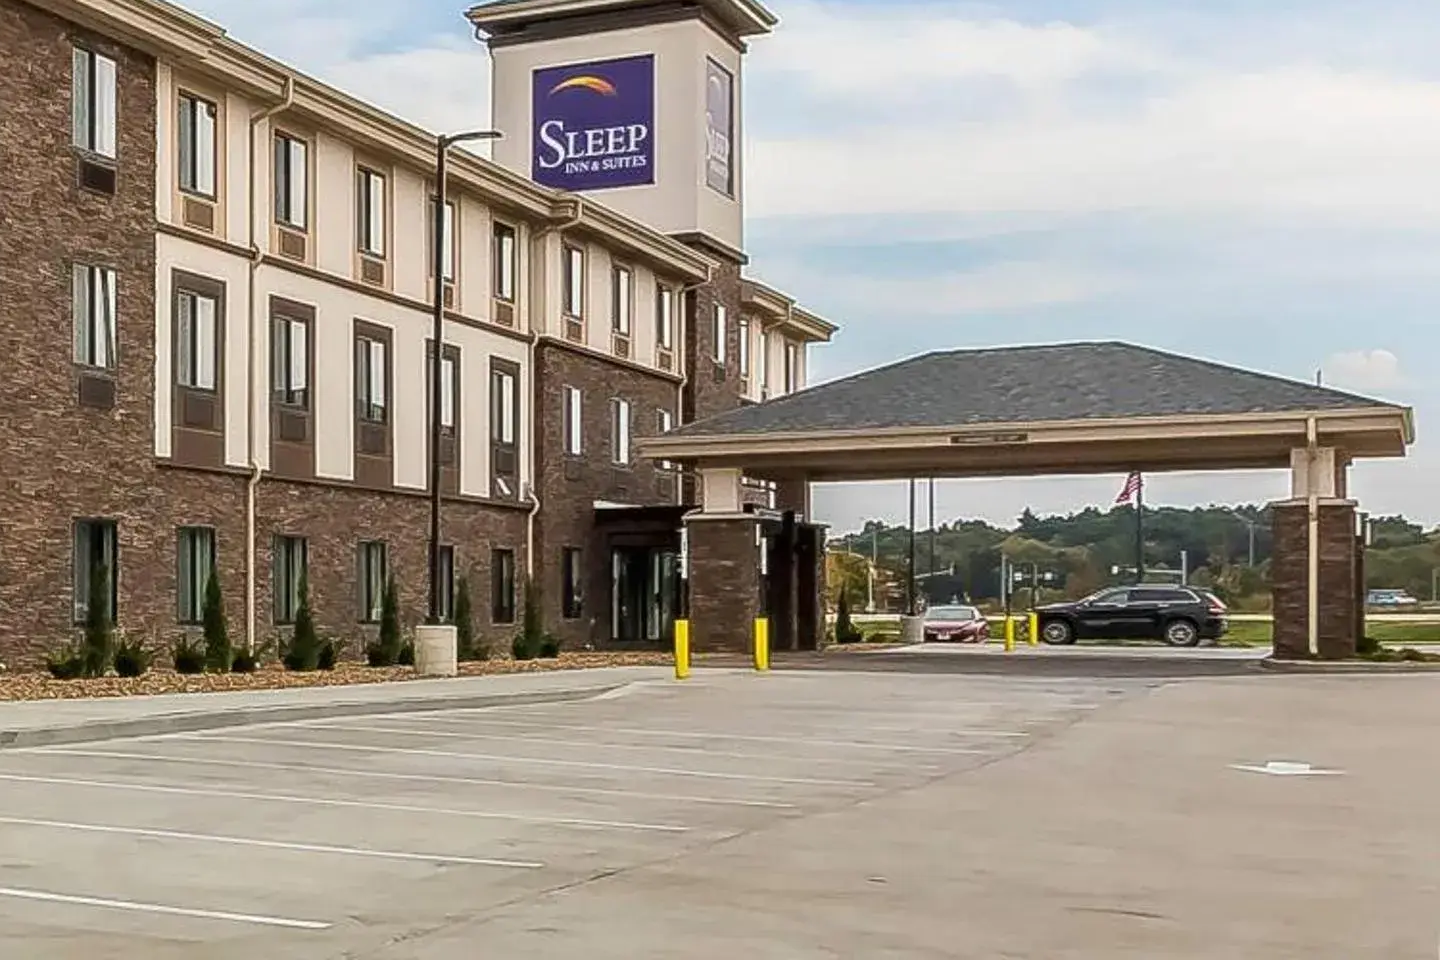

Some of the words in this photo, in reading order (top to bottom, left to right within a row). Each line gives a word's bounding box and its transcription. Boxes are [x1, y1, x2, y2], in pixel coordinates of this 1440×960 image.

[539, 120, 648, 168] SLEEP
[565, 161, 590, 174] INN
[590, 160, 600, 172] &
[602, 155, 647, 170] SUITES
